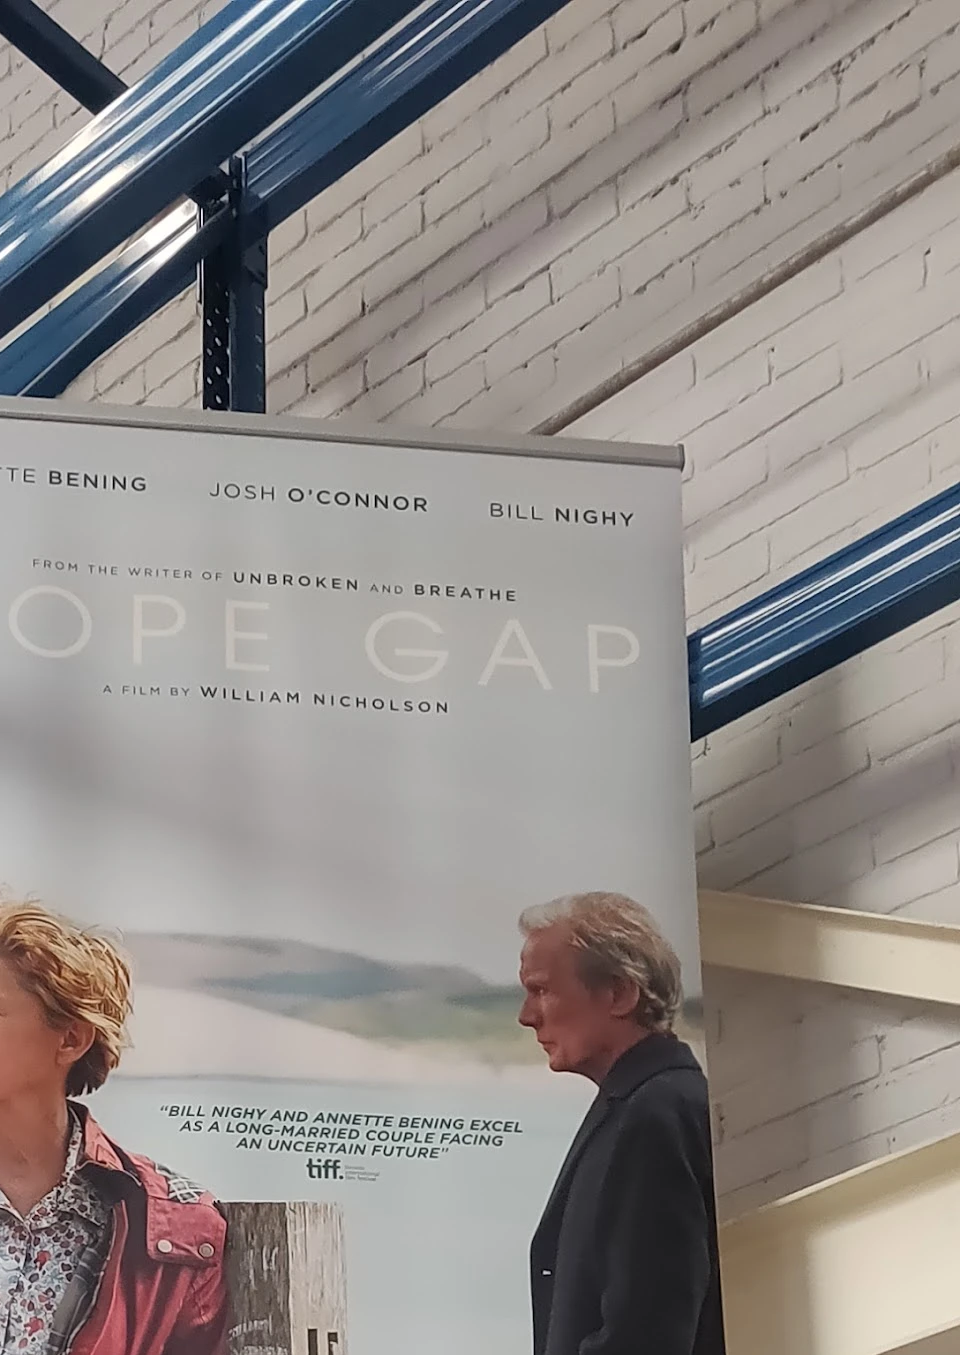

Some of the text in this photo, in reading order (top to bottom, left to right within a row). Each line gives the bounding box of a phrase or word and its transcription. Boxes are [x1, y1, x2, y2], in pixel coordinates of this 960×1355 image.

[48, 470, 147, 492] BENING
[209, 482, 429, 513] JOSH O'CONNOR
[490, 502, 635, 527] BILL NIGHY
[32, 558, 517, 602] FROM THE WRITER OF UNBROKEN AND BREATHE
[364, 610, 640, 693] GAP
[102, 685, 449, 714] A FILM BY WILLIAM NICHOLSON
[211, 1106, 267, 1120] NIGHY
[270, 1110, 308, 1123] AND
[313, 1112, 394, 1128] ANNETTE
[398, 1117, 464, 1130] BENING
[470, 1119, 523, 1133] EXCEL
[179, 1120, 504, 1147] AS A LONG-MARRIED COUPLE FACING
[236, 1137, 262, 1150] AN
[267, 1139, 366, 1155] UNCERTAIN
